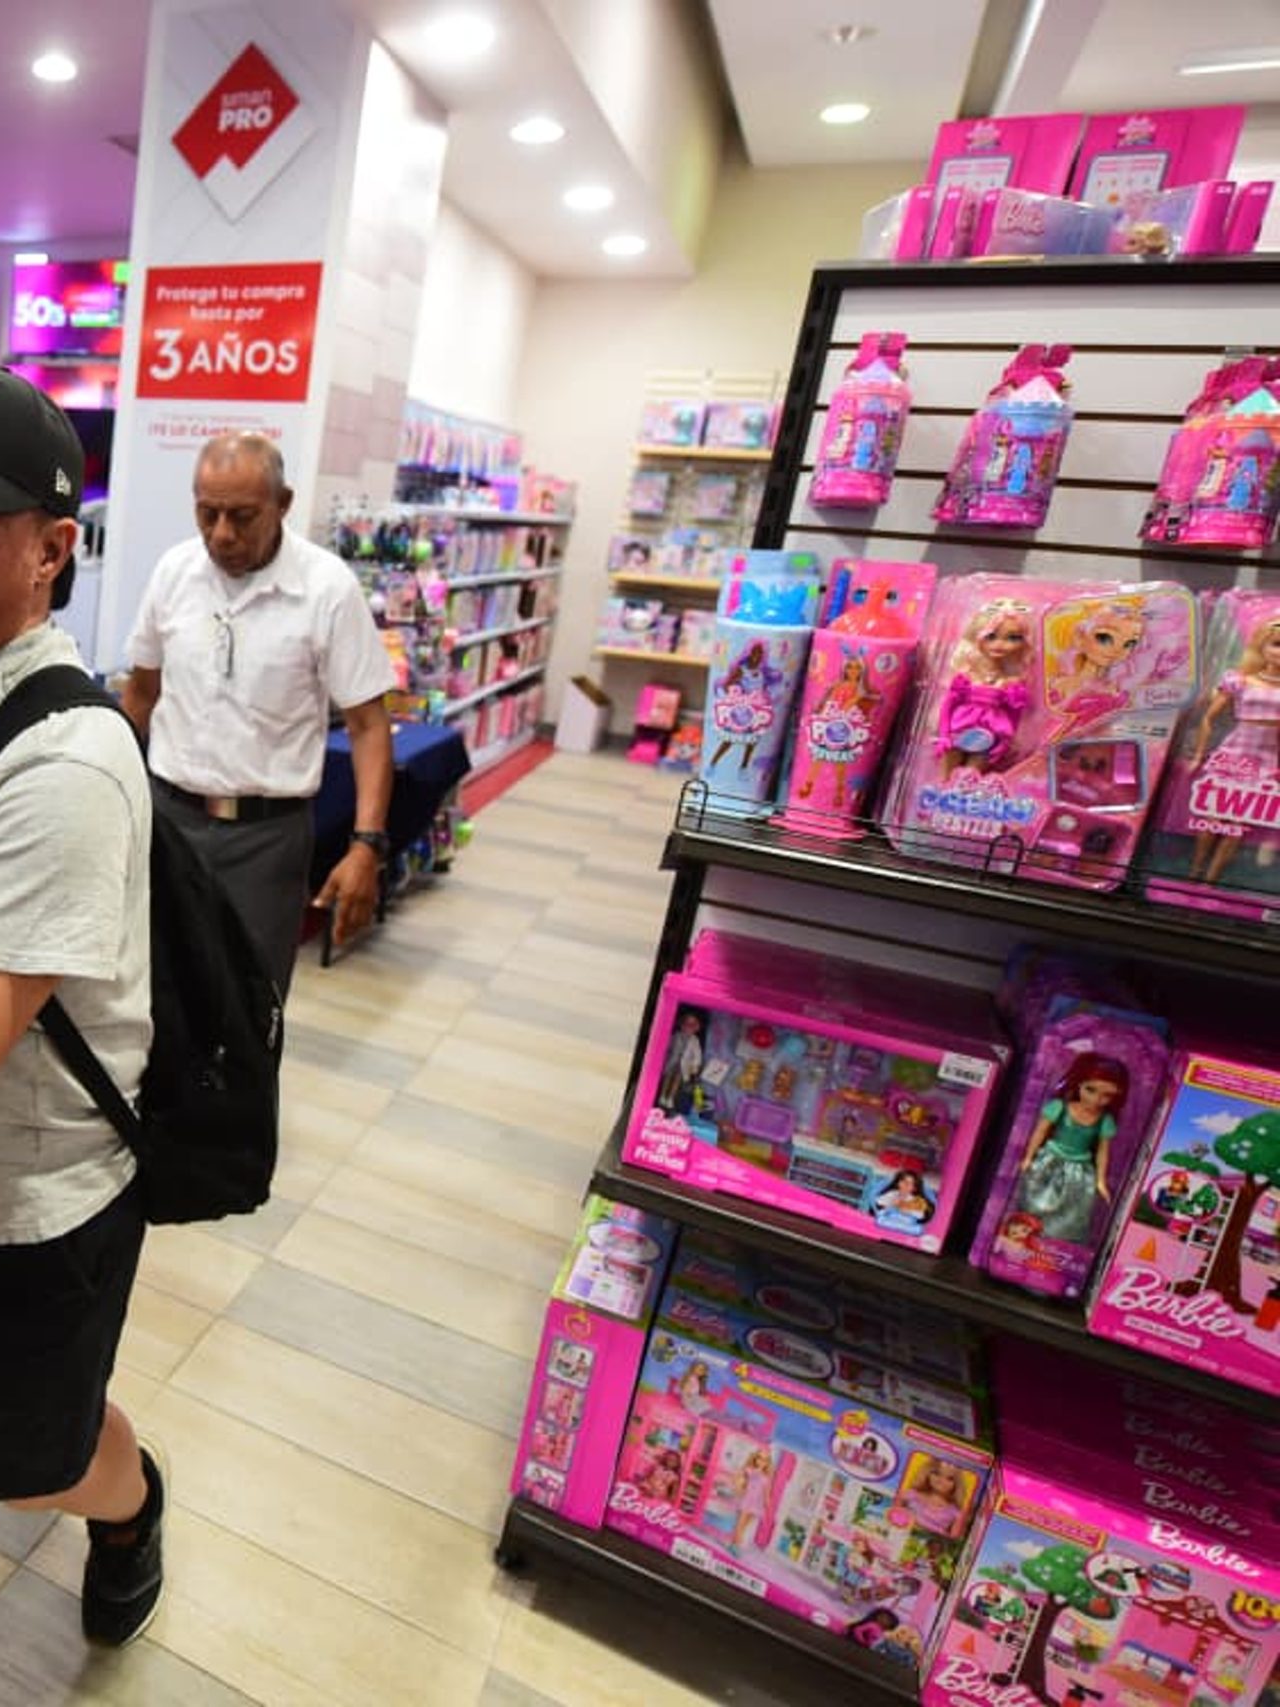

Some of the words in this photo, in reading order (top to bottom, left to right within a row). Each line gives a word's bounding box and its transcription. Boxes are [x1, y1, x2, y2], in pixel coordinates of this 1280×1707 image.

[218, 106, 273, 132] PRO
[157, 287, 218, 303] Protege
[222, 287, 238, 300] tu
[242, 285, 306, 301] compra
[190, 306, 232, 321] hasta
[235, 308, 265, 323] por
[149, 328, 183, 382] 3
[187, 331, 299, 376] AÑOS
[1106, 1266, 1246, 1337] Barbie
[609, 1482, 688, 1533] Barbie
[1140, 1478, 1252, 1537] Barbie
[1142, 1516, 1262, 1577] Barbie
